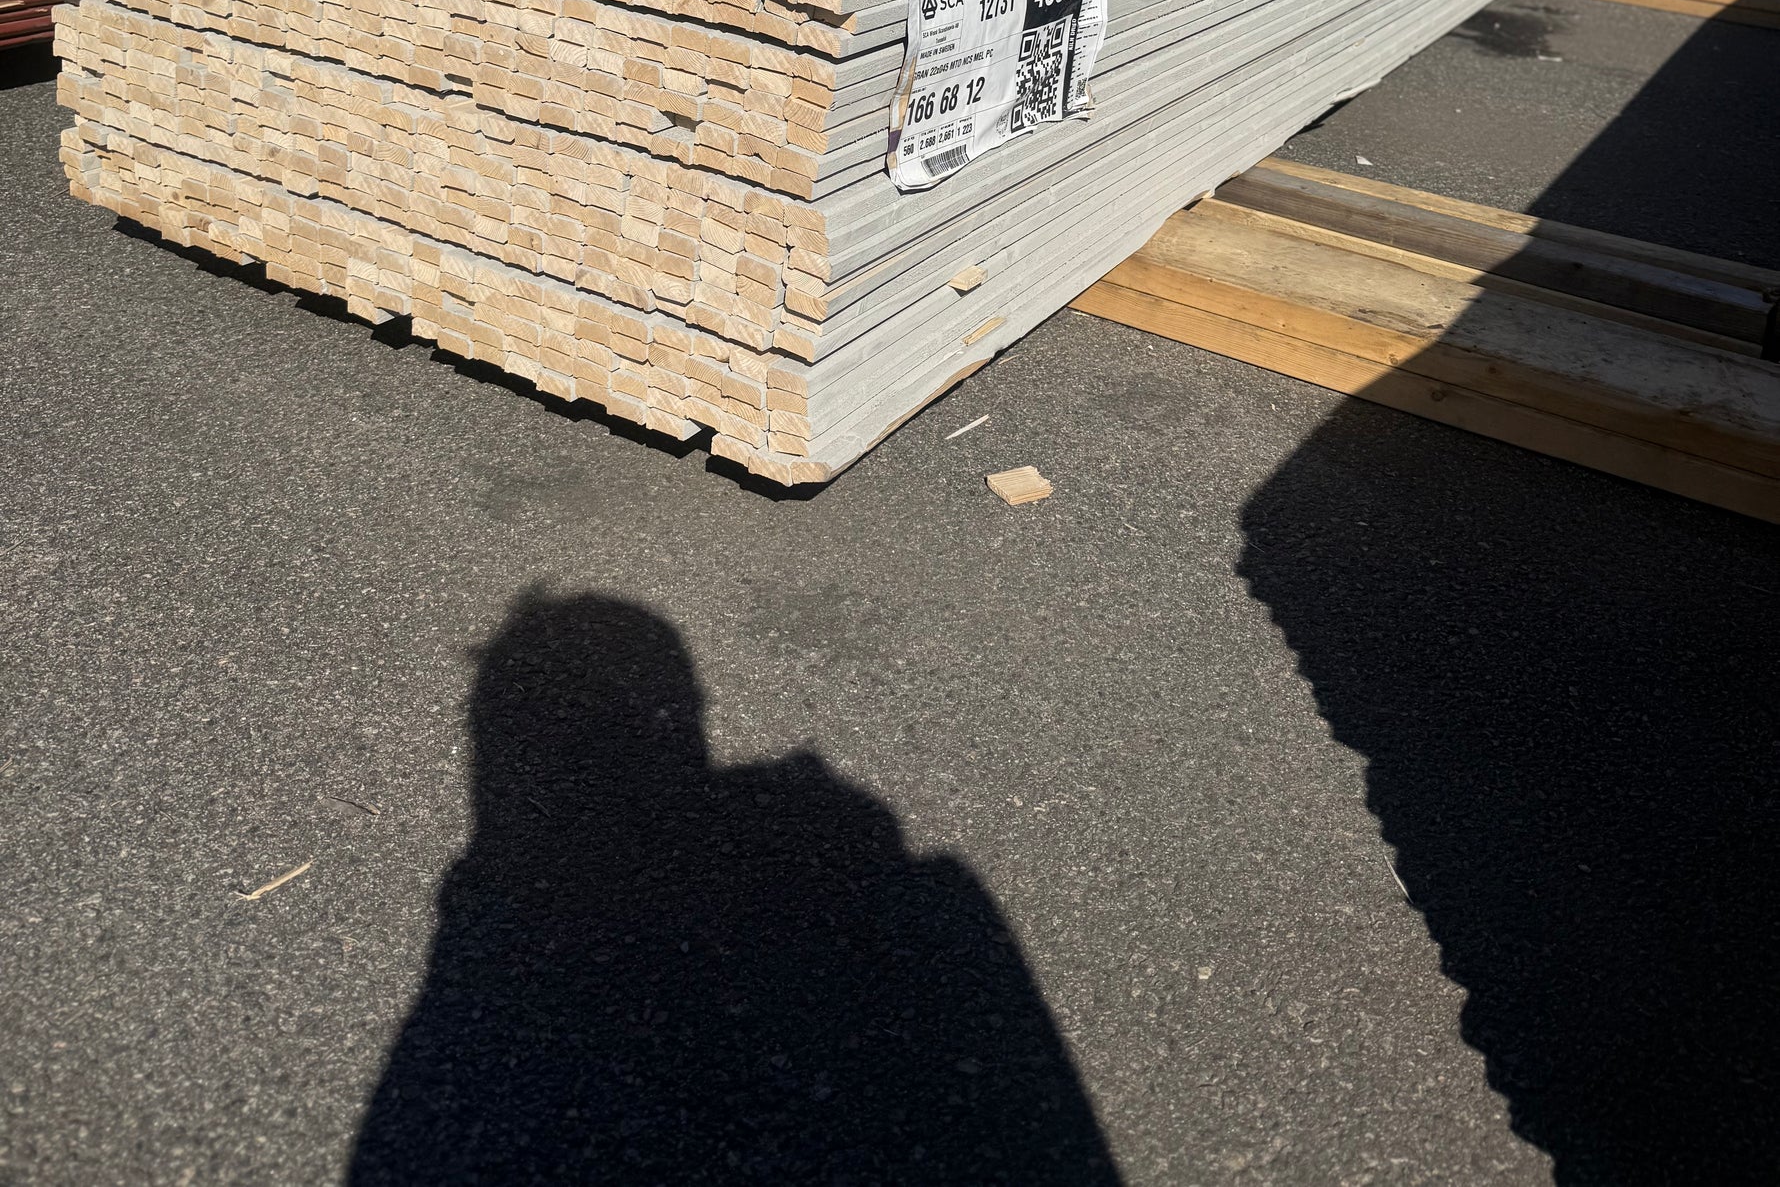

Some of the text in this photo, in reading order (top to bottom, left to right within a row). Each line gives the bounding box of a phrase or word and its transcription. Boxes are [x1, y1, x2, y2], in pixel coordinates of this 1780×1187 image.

[920, 43, 956, 60] MADE IN SWEDEN
[962, 54, 974, 66] NCS
[907, 76, 986, 126] 166 68 12
[903, 143, 915, 157] 560
[962, 123, 973, 135] 223
